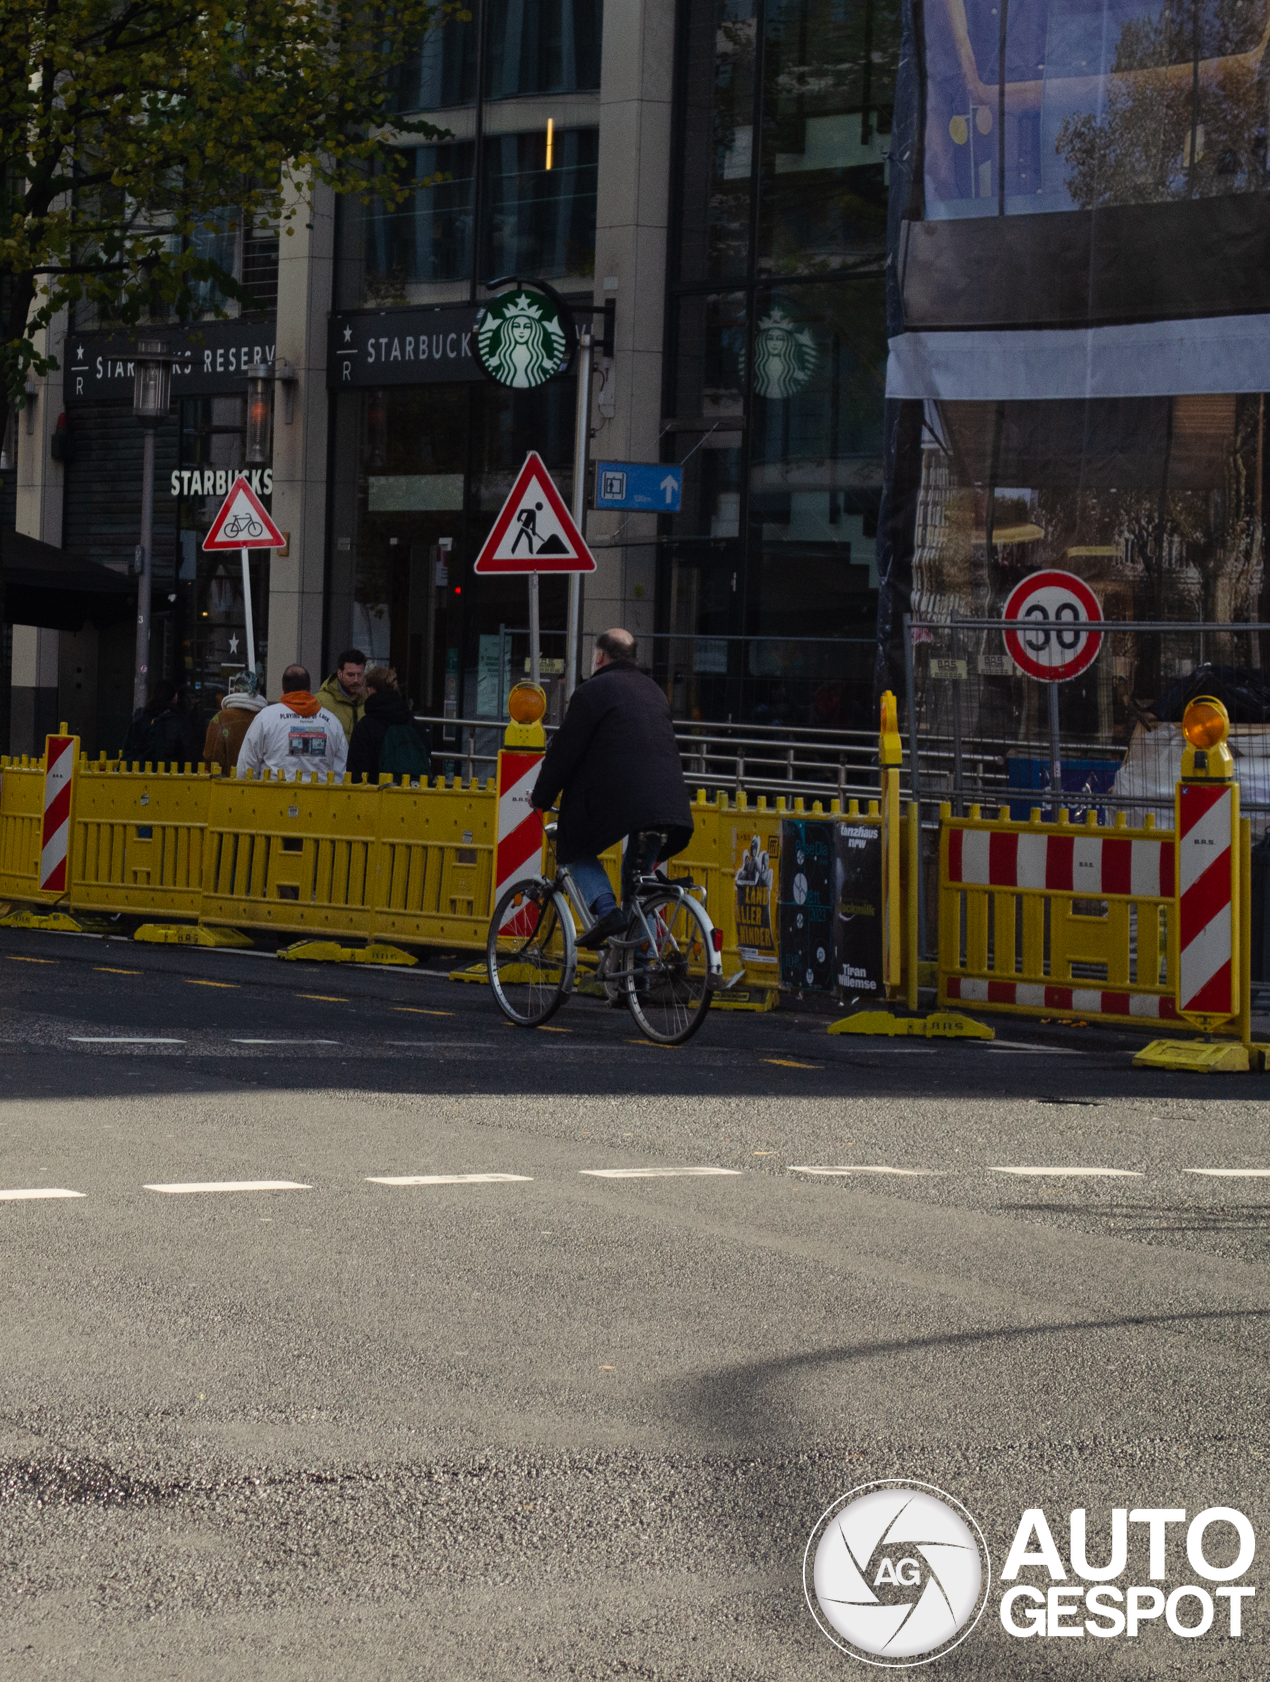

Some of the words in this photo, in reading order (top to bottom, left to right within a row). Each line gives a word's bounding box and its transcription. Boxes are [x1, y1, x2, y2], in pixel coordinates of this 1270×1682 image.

[342, 361, 352, 381] R
[76, 376, 84, 395] R
[1024, 602, 1081, 652] 30
[840, 825, 878, 839] tanzhaus
[847, 838, 867, 849] nrw
[843, 964, 867, 978] Tiran
